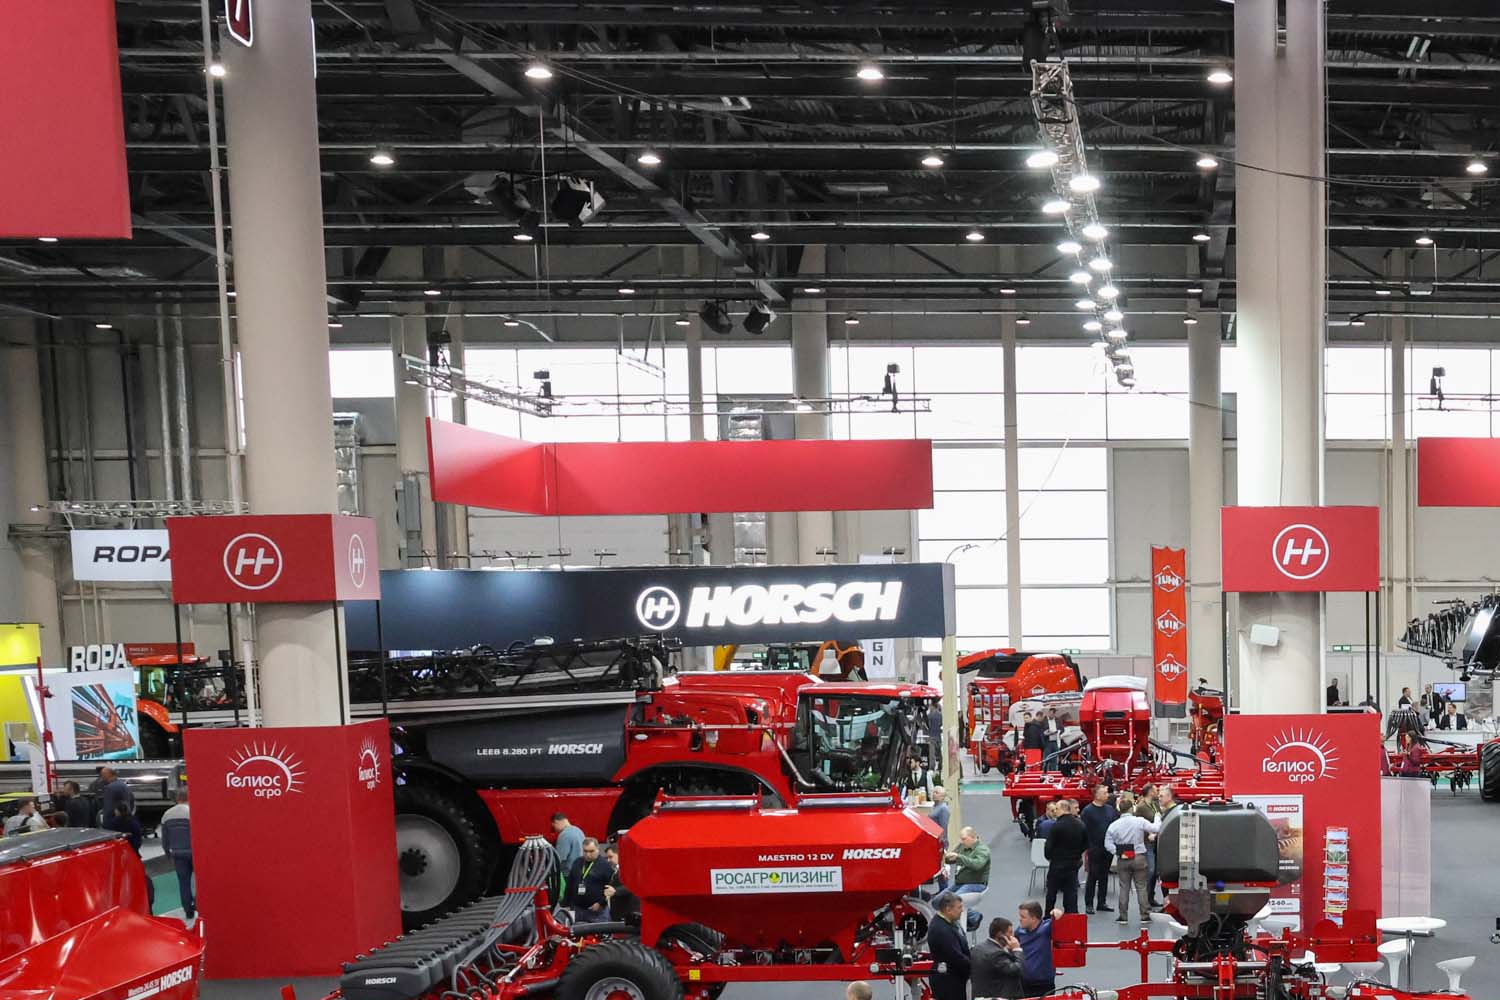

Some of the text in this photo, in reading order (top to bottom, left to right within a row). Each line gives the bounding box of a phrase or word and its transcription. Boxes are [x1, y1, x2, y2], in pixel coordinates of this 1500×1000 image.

[686, 581, 902, 628] HORSCH
[72, 643, 127, 673] ROPA
[548, 744, 603, 754] HORSCH
[1262, 758, 1315, 773] Гелиос
[226, 772, 281, 787] Гелиос
[1288, 774, 1315, 784] агро
[254, 788, 281, 799] агро
[758, 854, 805, 862] MAESTRO
[820, 853, 834, 861] DV
[842, 848, 901, 859] HORSCH
[715, 870, 837, 885] РОСАГРОЛИЗИНГ
[160, 965, 193, 991] HORSCH
[365, 977, 397, 985] HORSCH
